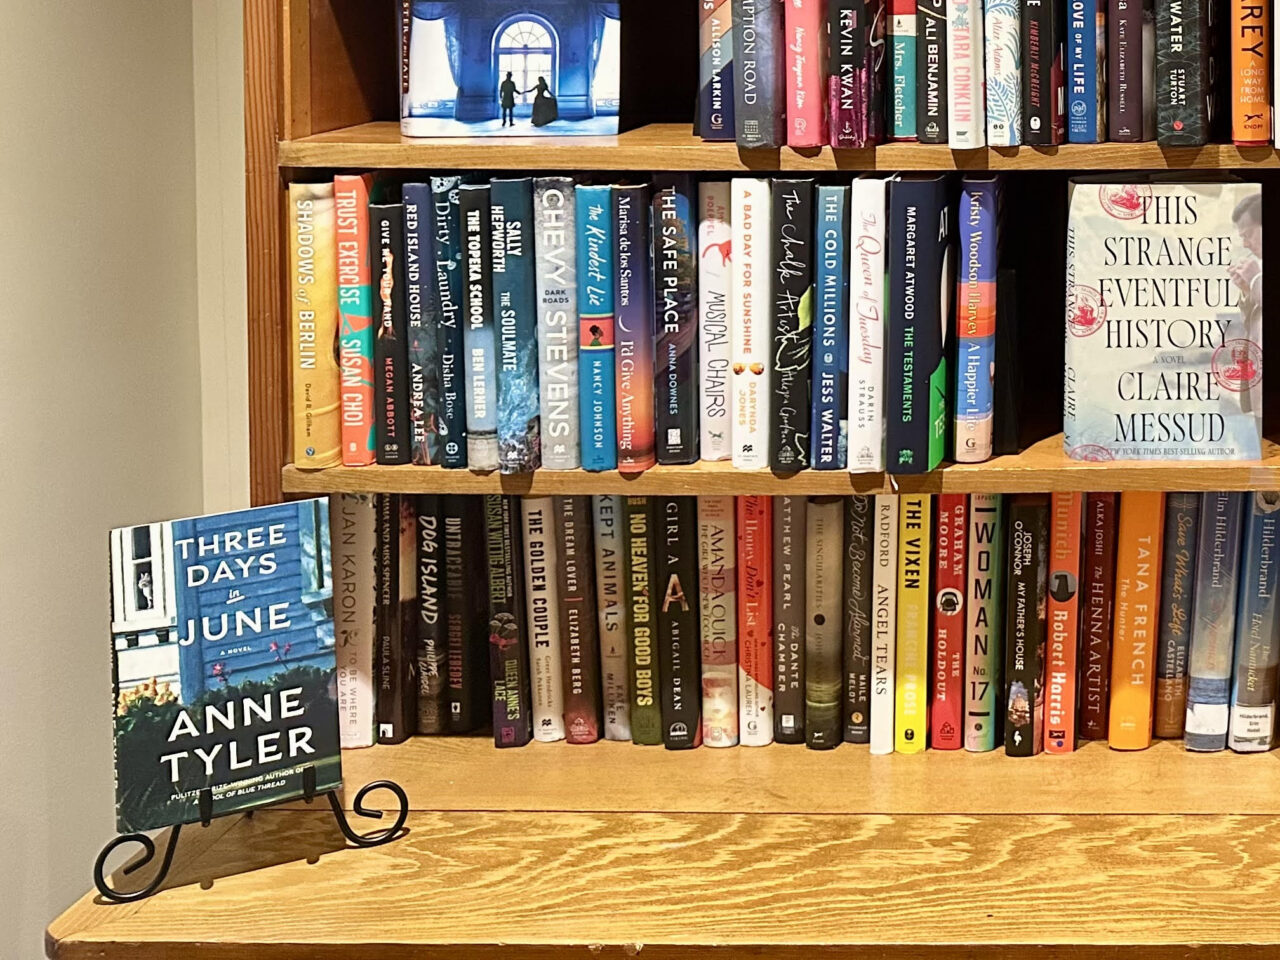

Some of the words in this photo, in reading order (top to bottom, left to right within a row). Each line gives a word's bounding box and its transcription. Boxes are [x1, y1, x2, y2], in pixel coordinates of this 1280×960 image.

[1141, 196, 1197, 225] THIS
[542, 188, 566, 286] CHEVY
[1104, 237, 1232, 266] STRANGE
[1097, 278, 1241, 307] EVENTFUL
[1106, 319, 1232, 349] HISTORY
[545, 310, 569, 437] STEVENS
[1117, 372, 1220, 401] CLAIRE
[1114, 413, 1225, 442] MESSUD
[175, 524, 287, 559] THREE
[187, 552, 277, 588] DAYS
[1136, 536, 1151, 592] TANA
[227, 589, 245, 602] in
[179, 602, 291, 646] JUNE
[1052, 610, 1068, 667] Robert
[228, 646, 252, 654] NOVEL
[1131, 605, 1148, 685] FRENCH
[167, 687, 304, 742] ANNE
[1050, 672, 1066, 724] Harris
[160, 726, 316, 782] TYLER
